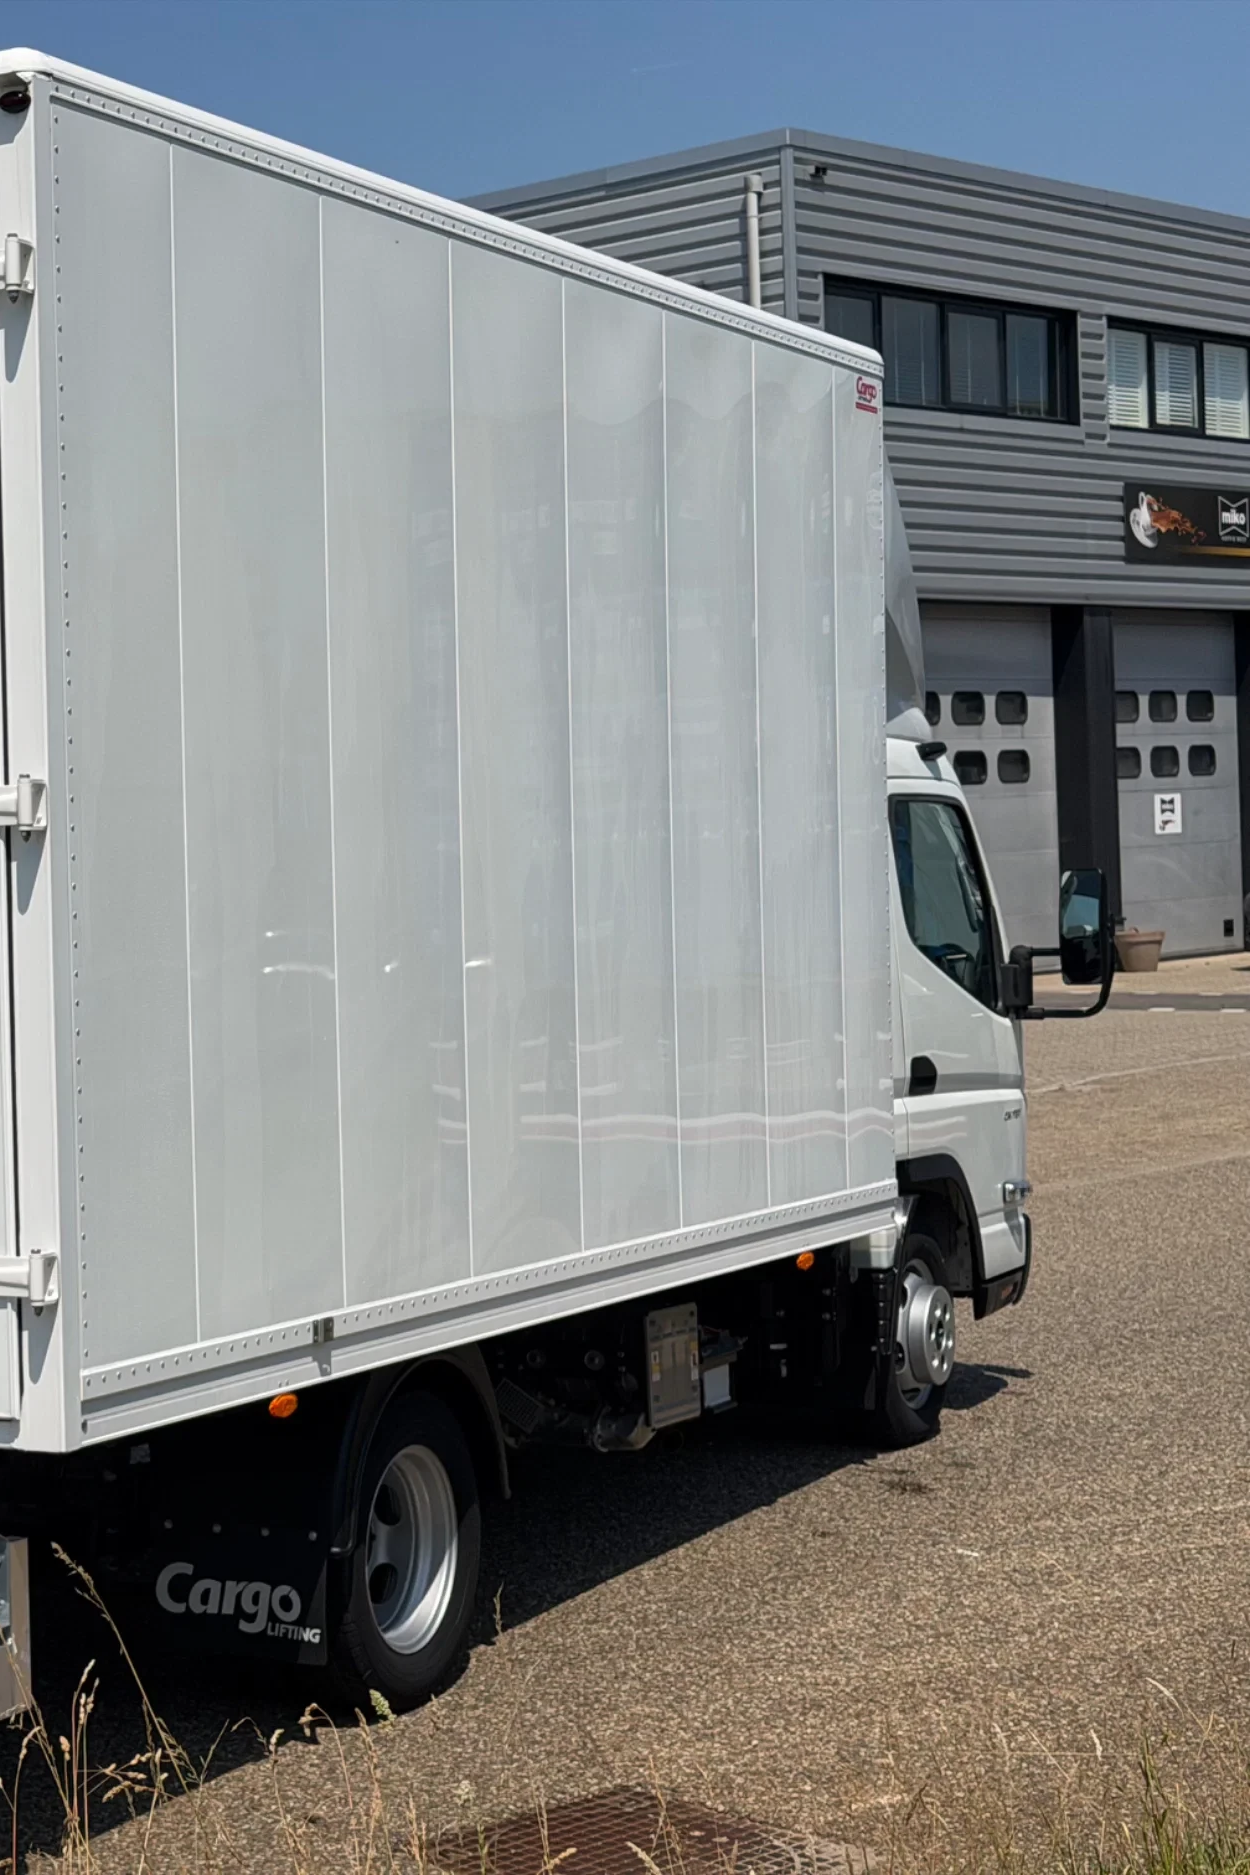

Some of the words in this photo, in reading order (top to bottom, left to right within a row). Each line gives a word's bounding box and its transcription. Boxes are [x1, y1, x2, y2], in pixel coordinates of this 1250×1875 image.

[1222, 508, 1246, 525] miko
[155, 1562, 301, 1633] Cargo
[267, 1621, 321, 1644] LIFTING
